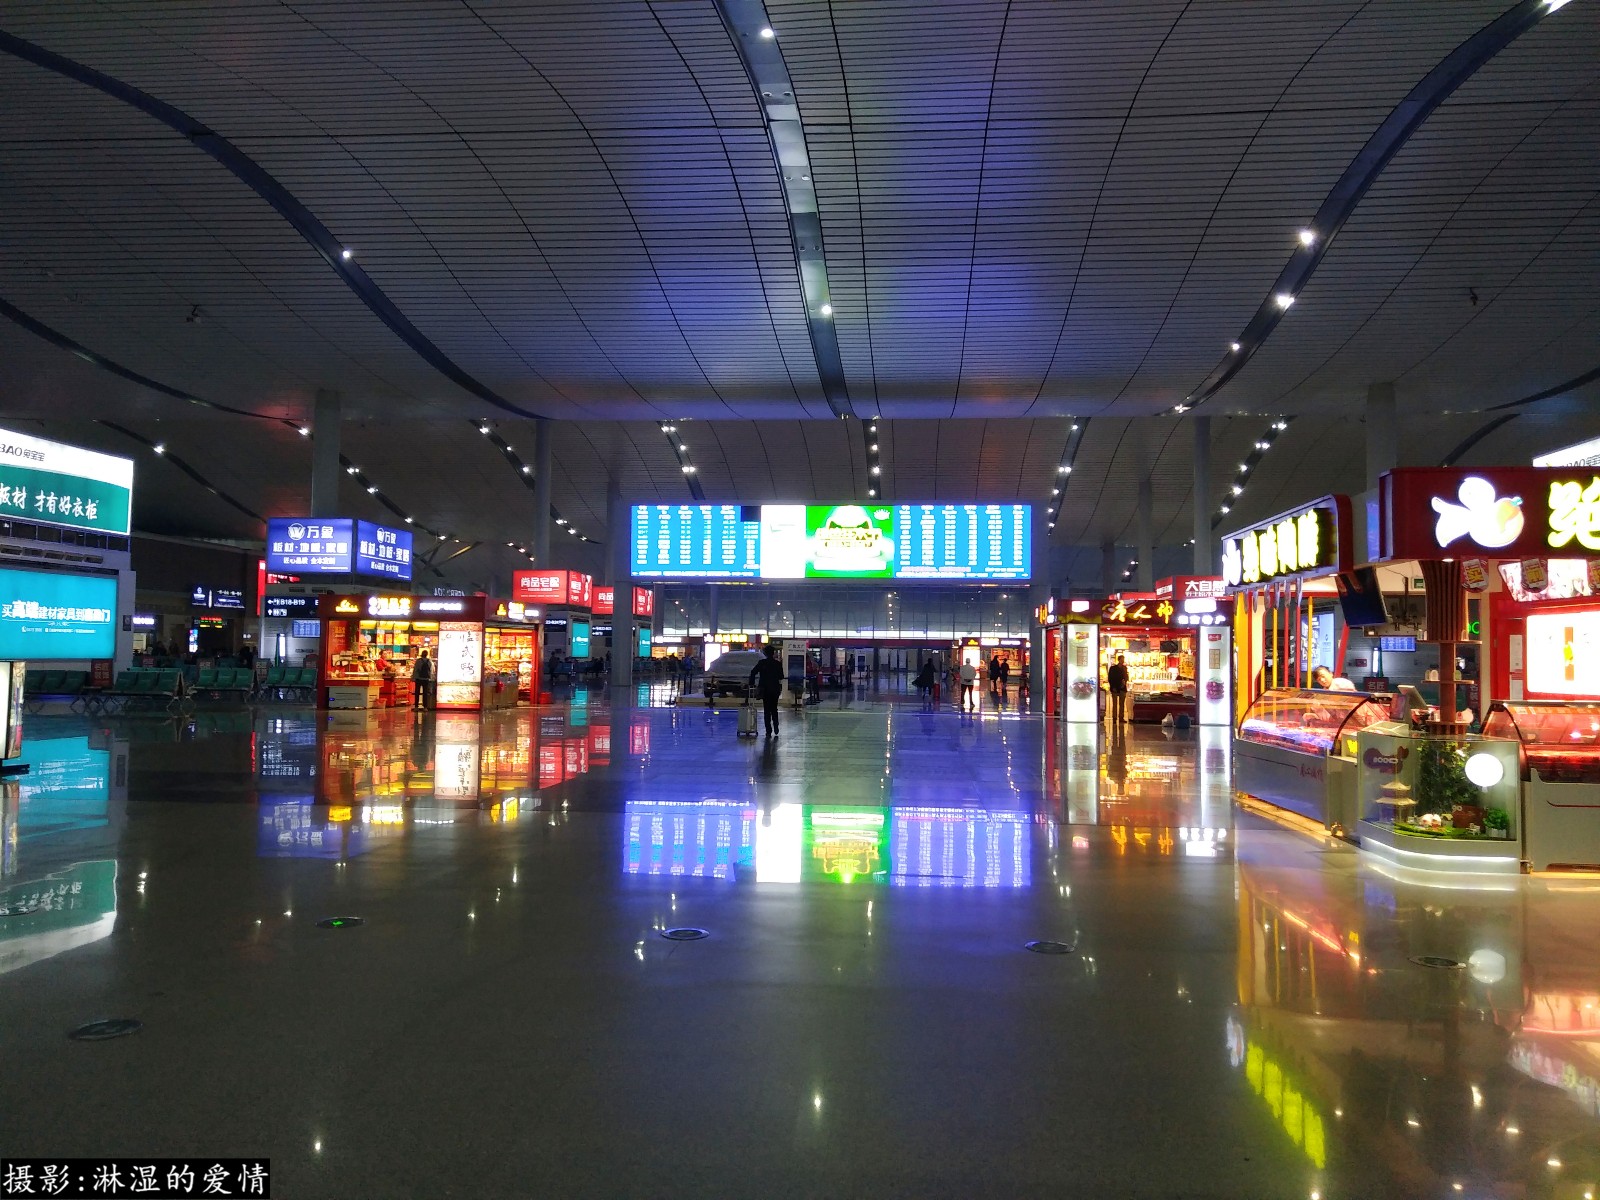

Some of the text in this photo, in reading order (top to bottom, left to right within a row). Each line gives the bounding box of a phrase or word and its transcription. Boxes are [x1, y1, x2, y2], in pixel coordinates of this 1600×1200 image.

[34, 489, 99, 521] 才有好衣柜
[520, 576, 560, 588] 尚品宅配
[1110, 599, 1174, 625] 唐人神
